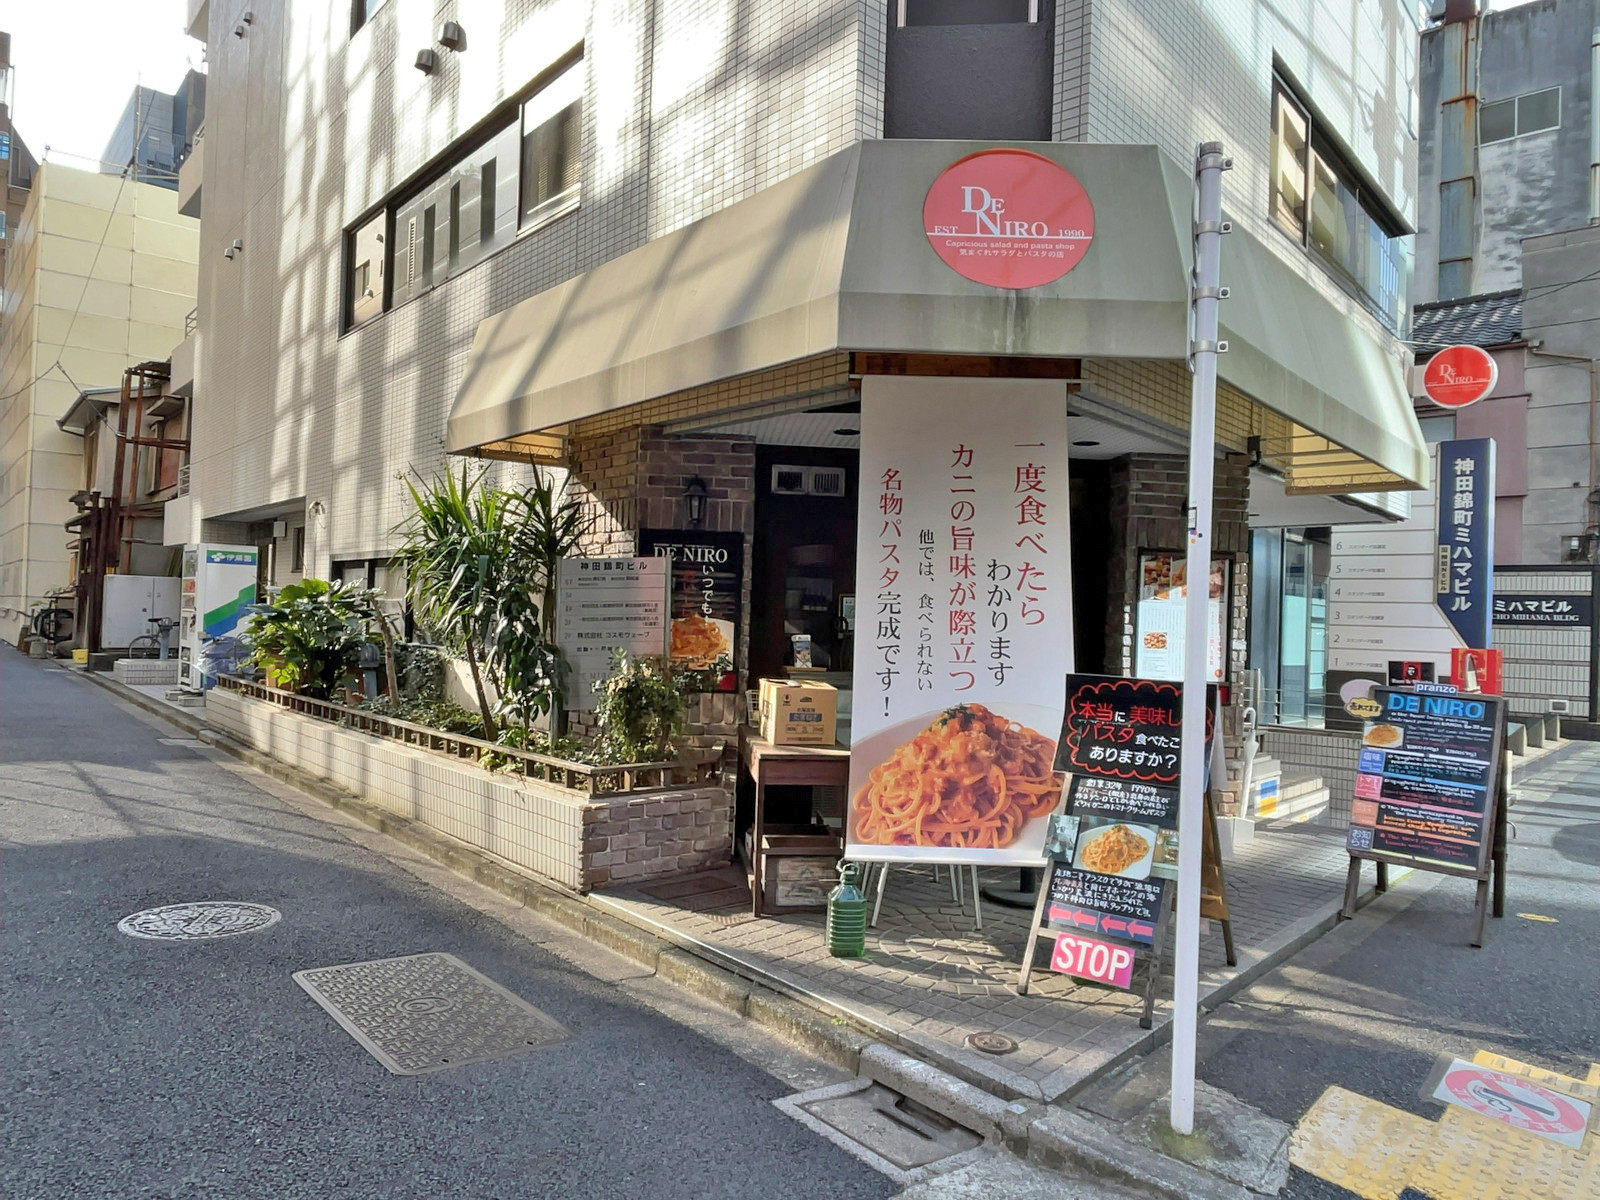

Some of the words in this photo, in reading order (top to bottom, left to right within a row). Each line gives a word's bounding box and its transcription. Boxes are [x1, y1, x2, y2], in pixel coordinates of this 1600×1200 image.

[961, 186, 1005, 213] DE
[934, 226, 958, 234] EST
[975, 211, 1049, 237] NIRO
[1058, 229, 1085, 238] 1990
[946, 240, 988, 248] Capricious
[1013, 241, 1028, 249] and
[1055, 243, 1075, 251] shop
[1014, 442, 1048, 626] 一度食べたら
[1336, 541, 1342, 550] 6
[1450, 458, 1475, 613] 神田錦町ミハマビル
[580, 562, 648, 571] 神田錦町ビル
[653, 547, 677, 561] DE
[683, 548, 728, 563] NIRO
[948, 443, 977, 691] カニの旨味が際立つ
[1336, 565, 1342, 573] 5
[875, 468, 903, 717] 名物パスタ完成です！
[1335, 588, 1341, 596] 4
[916, 529, 935, 691] 他では、食べられない
[1334, 611, 1340, 620] 3
[1494, 600, 1573, 612] ミハマビル
[986, 559, 1014, 686] わかります
[1333, 634, 1340, 643] 2
[1416, 683, 1457, 694] pranzo
[1079, 701, 1182, 727] 本当に美味し
[1388, 693, 1419, 713] DE
[1424, 697, 1483, 719] NIRO
[1081, 724, 1181, 749] パスタ食べたこ
[1089, 746, 1177, 769] ありますか？
[1056, 937, 1130, 981] STOP
